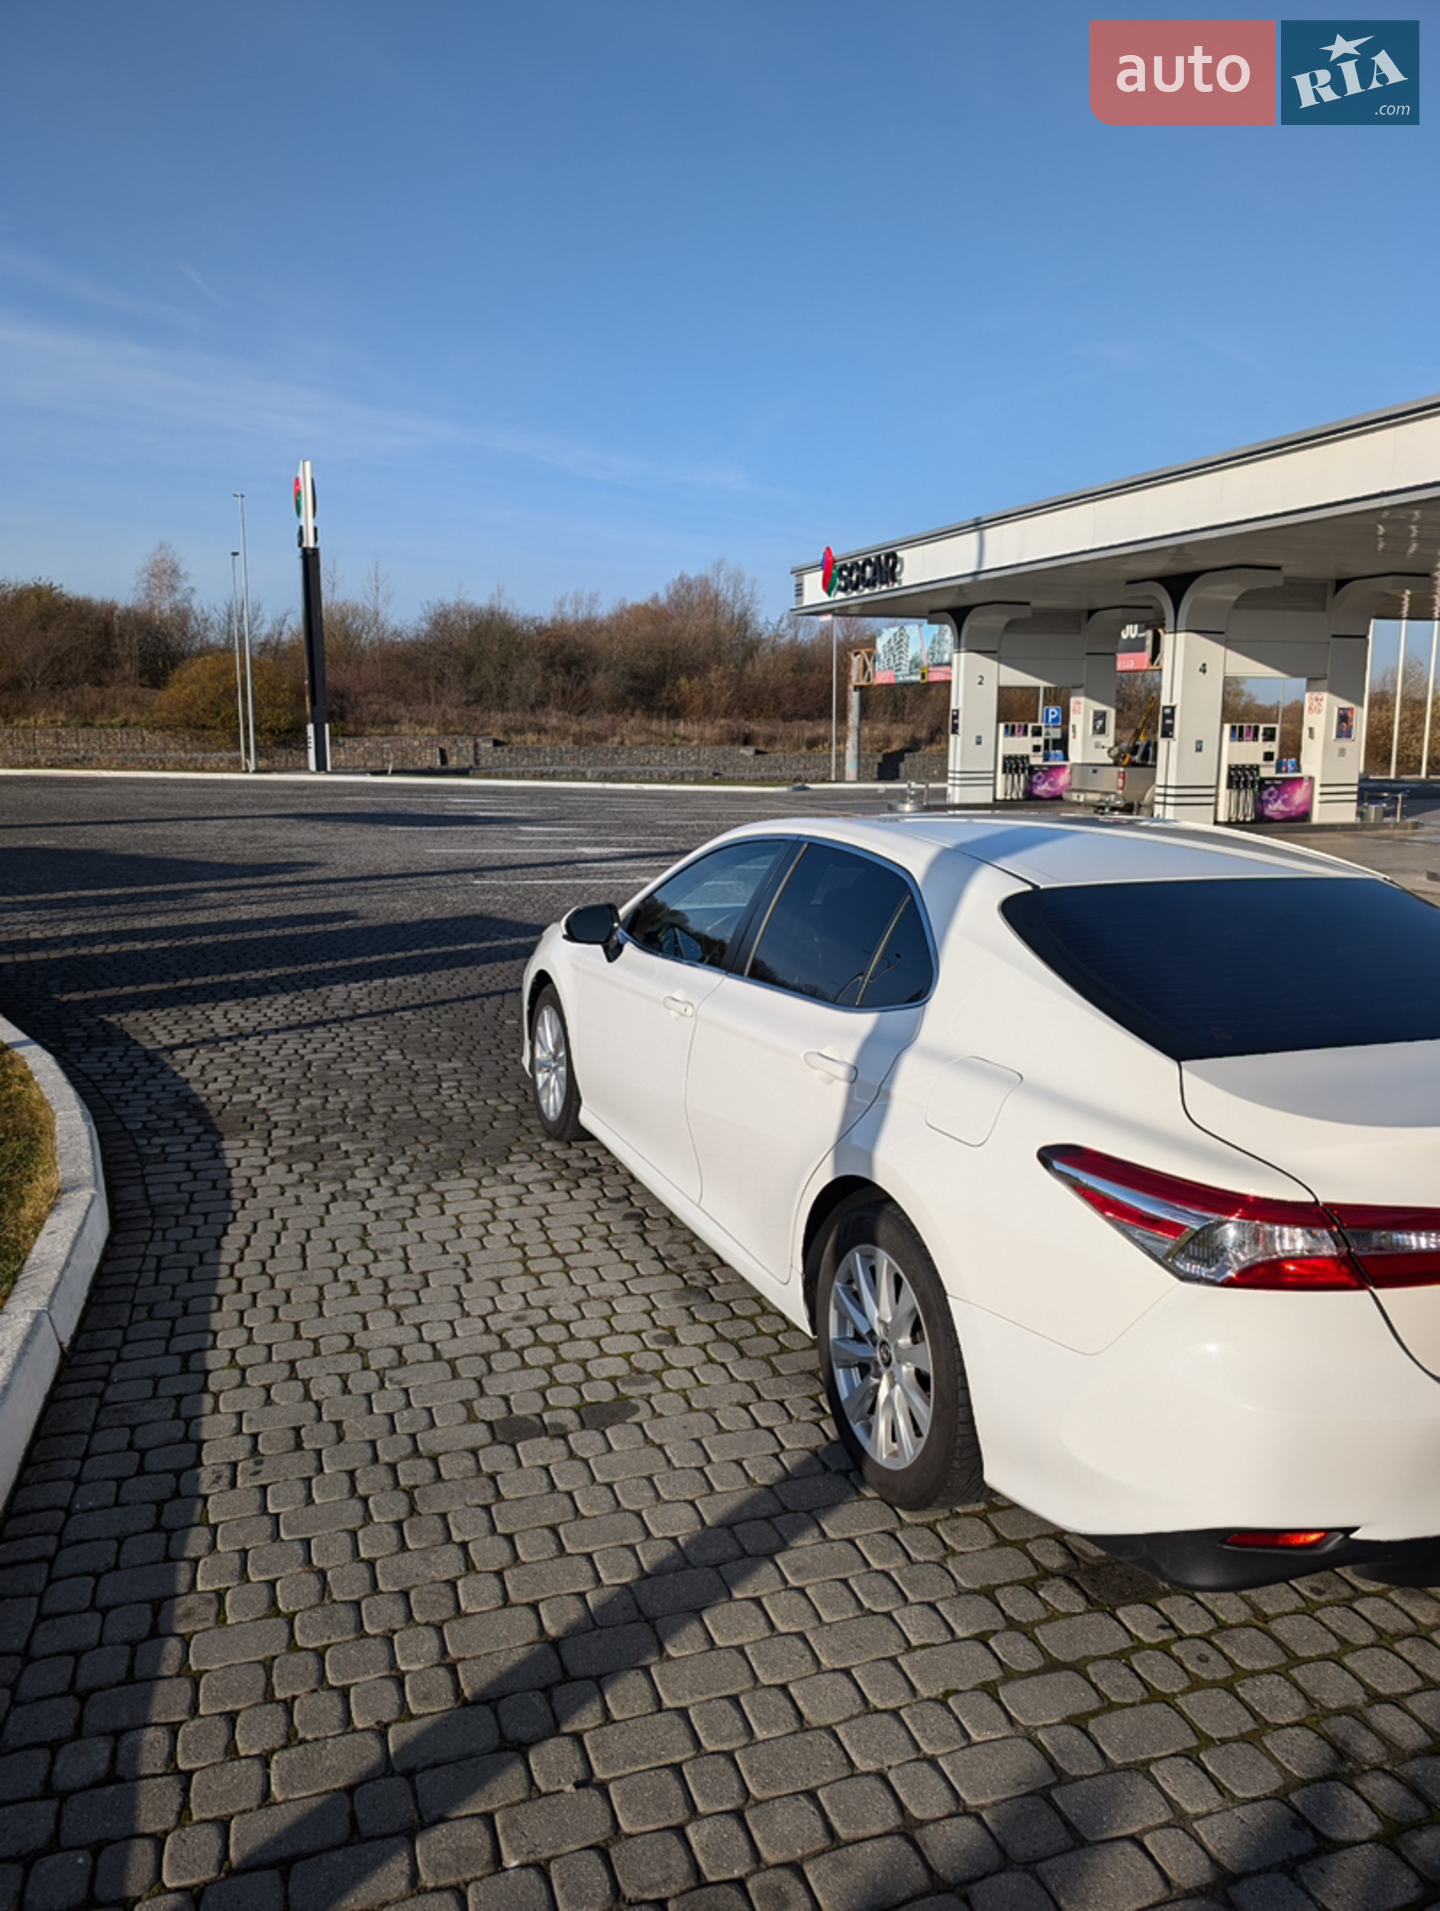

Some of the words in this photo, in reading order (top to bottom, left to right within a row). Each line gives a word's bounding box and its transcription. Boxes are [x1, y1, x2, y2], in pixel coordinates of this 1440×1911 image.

[836, 550, 901, 593] SOCAR
[1198, 662, 1208, 675] 4
[977, 675, 985, 686] 2
[1048, 707, 1059, 723] P
